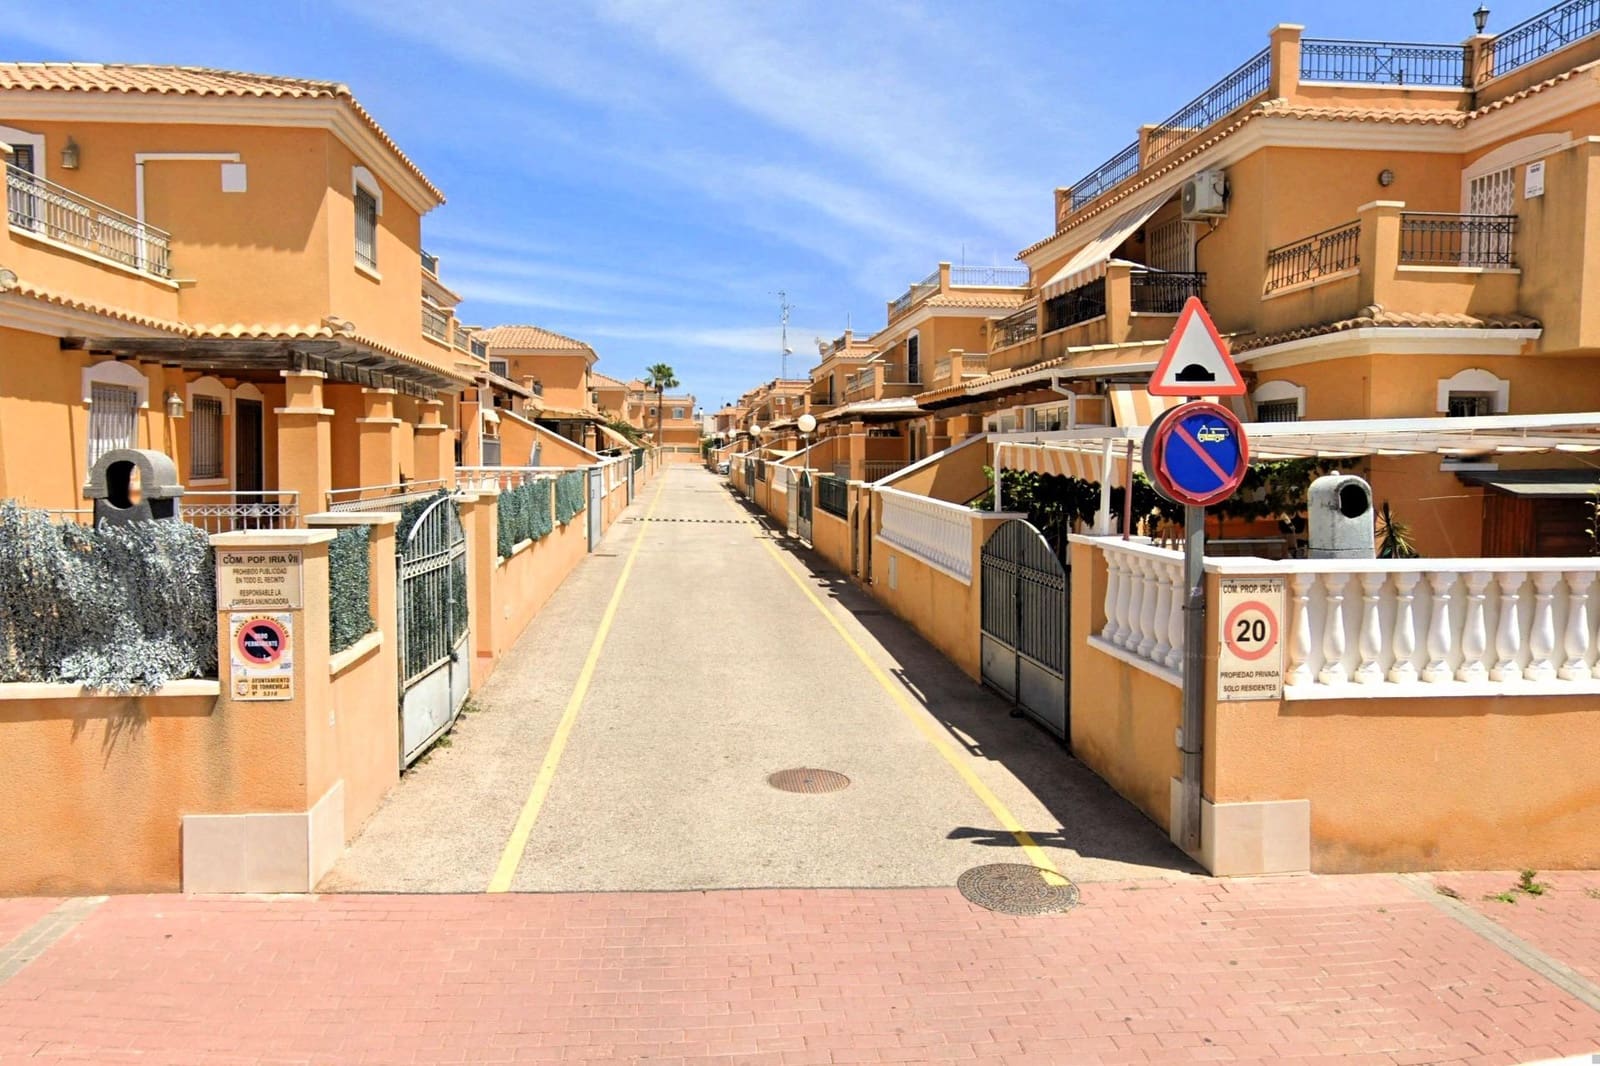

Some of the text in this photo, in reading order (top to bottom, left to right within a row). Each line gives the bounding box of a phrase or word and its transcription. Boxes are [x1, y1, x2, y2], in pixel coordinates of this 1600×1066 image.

[268, 555, 286, 564] IRIA
[288, 554, 298, 564] VII
[259, 567, 287, 575] PUBLICIDAD
[264, 576, 285, 584] RECINTO
[1260, 584, 1272, 593] IRIA
[239, 589, 274, 597] RESPONSABLE
[1236, 619, 1266, 642] 20
[1220, 670, 1280, 679] PROPIEDAD PRIVADA
[1240, 684, 1277, 692] RESIDENTES
